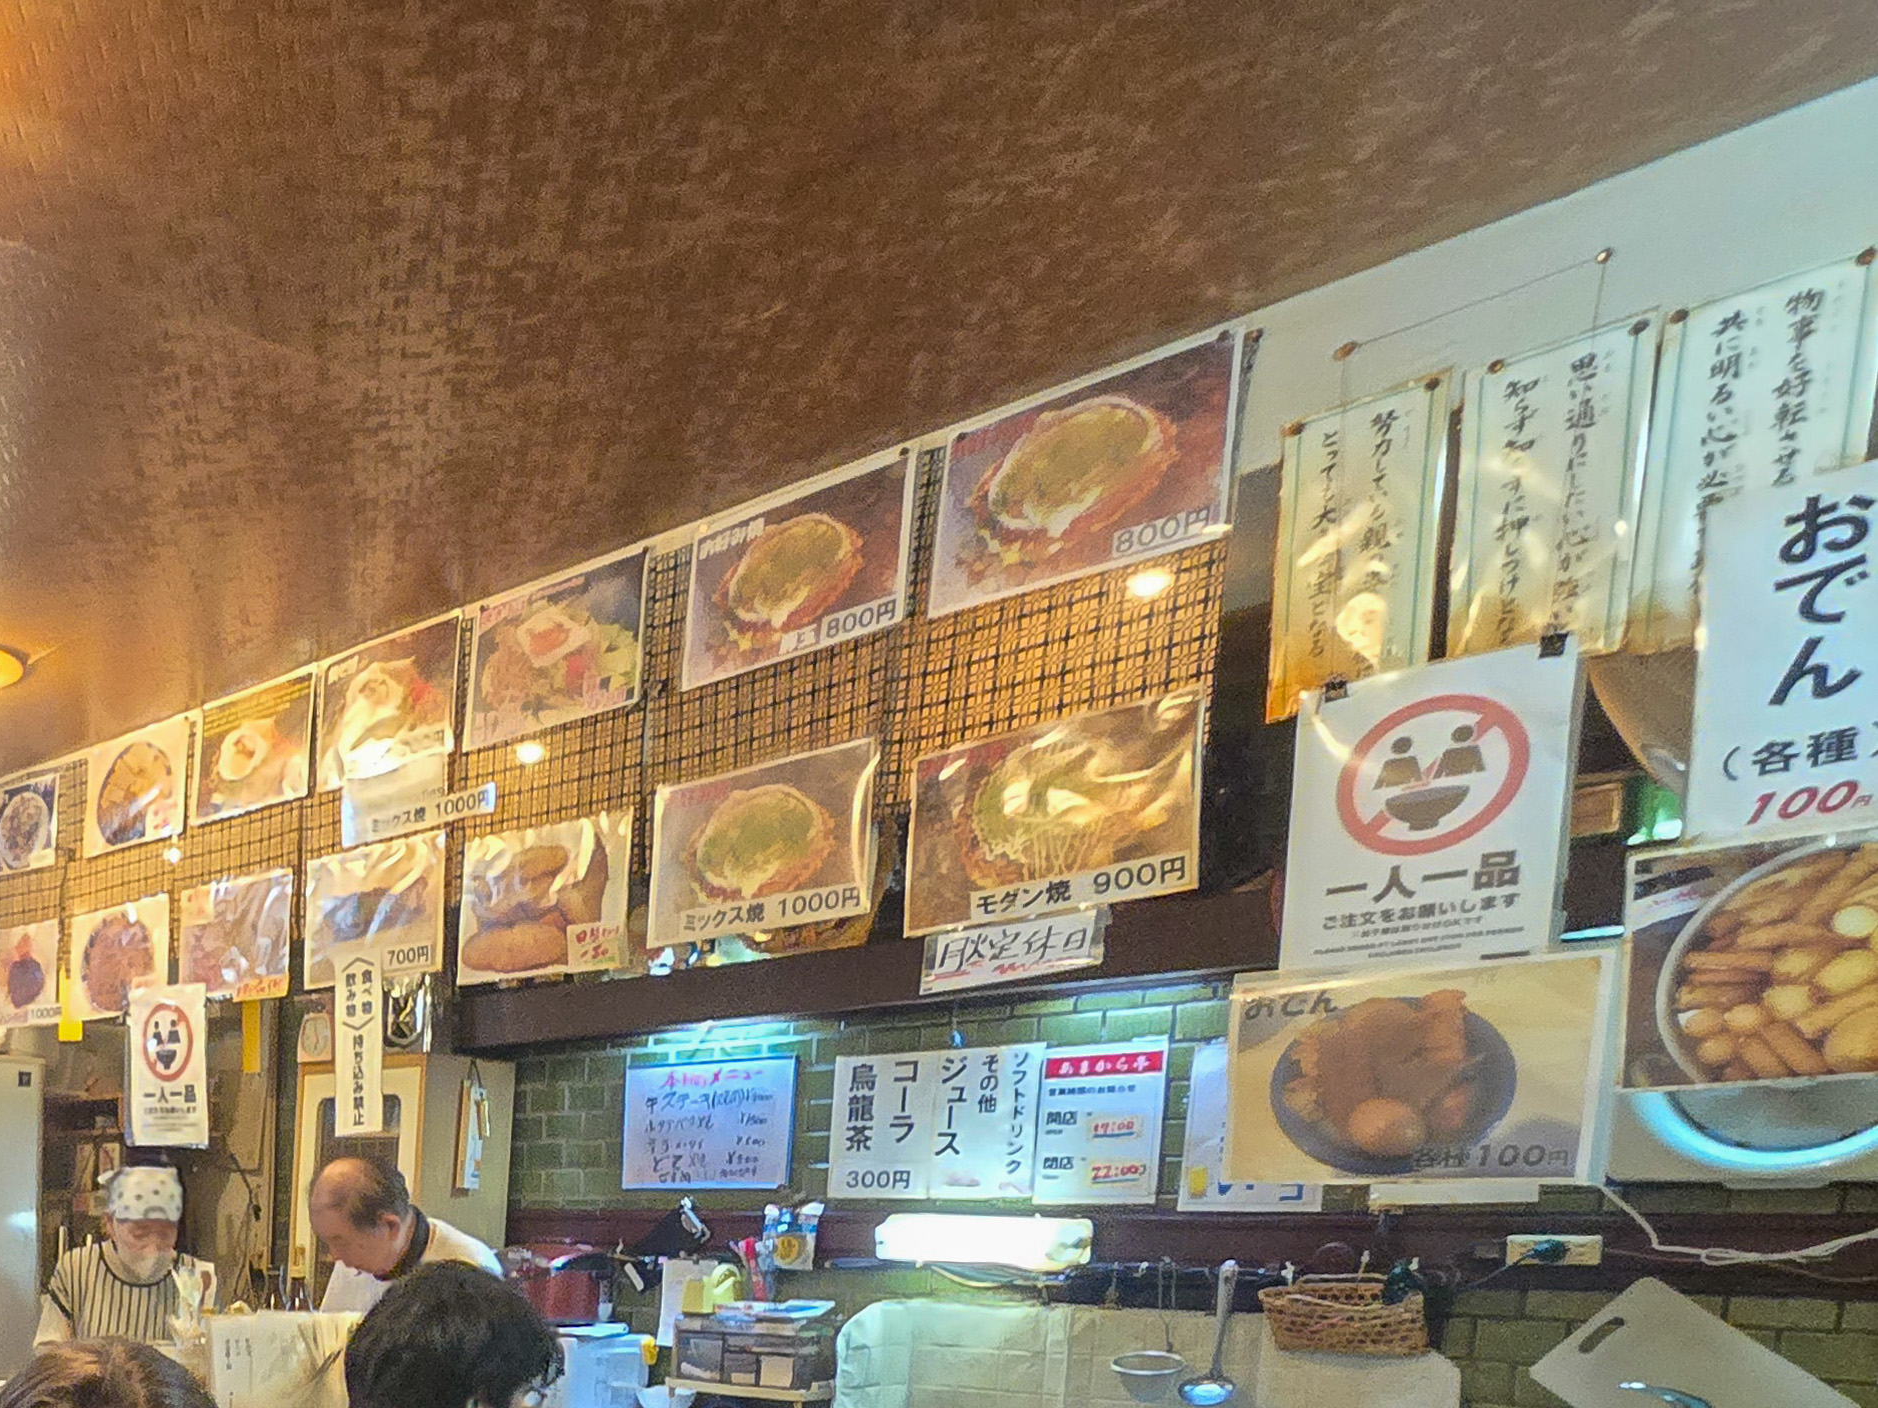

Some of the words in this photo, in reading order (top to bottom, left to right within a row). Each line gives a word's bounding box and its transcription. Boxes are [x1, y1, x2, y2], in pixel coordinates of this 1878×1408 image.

[1115, 508, 1213, 554] 800円
[825, 598, 897, 640] 800円
[1770, 494, 1876, 706] おでん
[435, 788, 490, 819] 1000円
[1737, 788, 1874, 826] 100円
[975, 881, 1073, 915] モダン焼
[1093, 855, 1187, 896] 900円
[1325, 850, 1521, 904] 一人一品
[682, 901, 766, 932] ミックス焼
[777, 885, 862, 918] 1000円
[1323, 892, 1521, 931] ご注文をお願いします
[387, 944, 430, 966] 700円
[143, 1083, 197, 1104] 一人一品
[352, 1033, 365, 1127] 持ち込み禁止
[889, 1060, 920, 1144] コーラ
[977, 1053, 1000, 1115] その他
[845, 1063, 879, 1153] 烏龍茶
[934, 1055, 968, 1157] ジュース
[1005, 1051, 1030, 1175] ソフトドリンク
[845, 1169, 912, 1190] 300円
